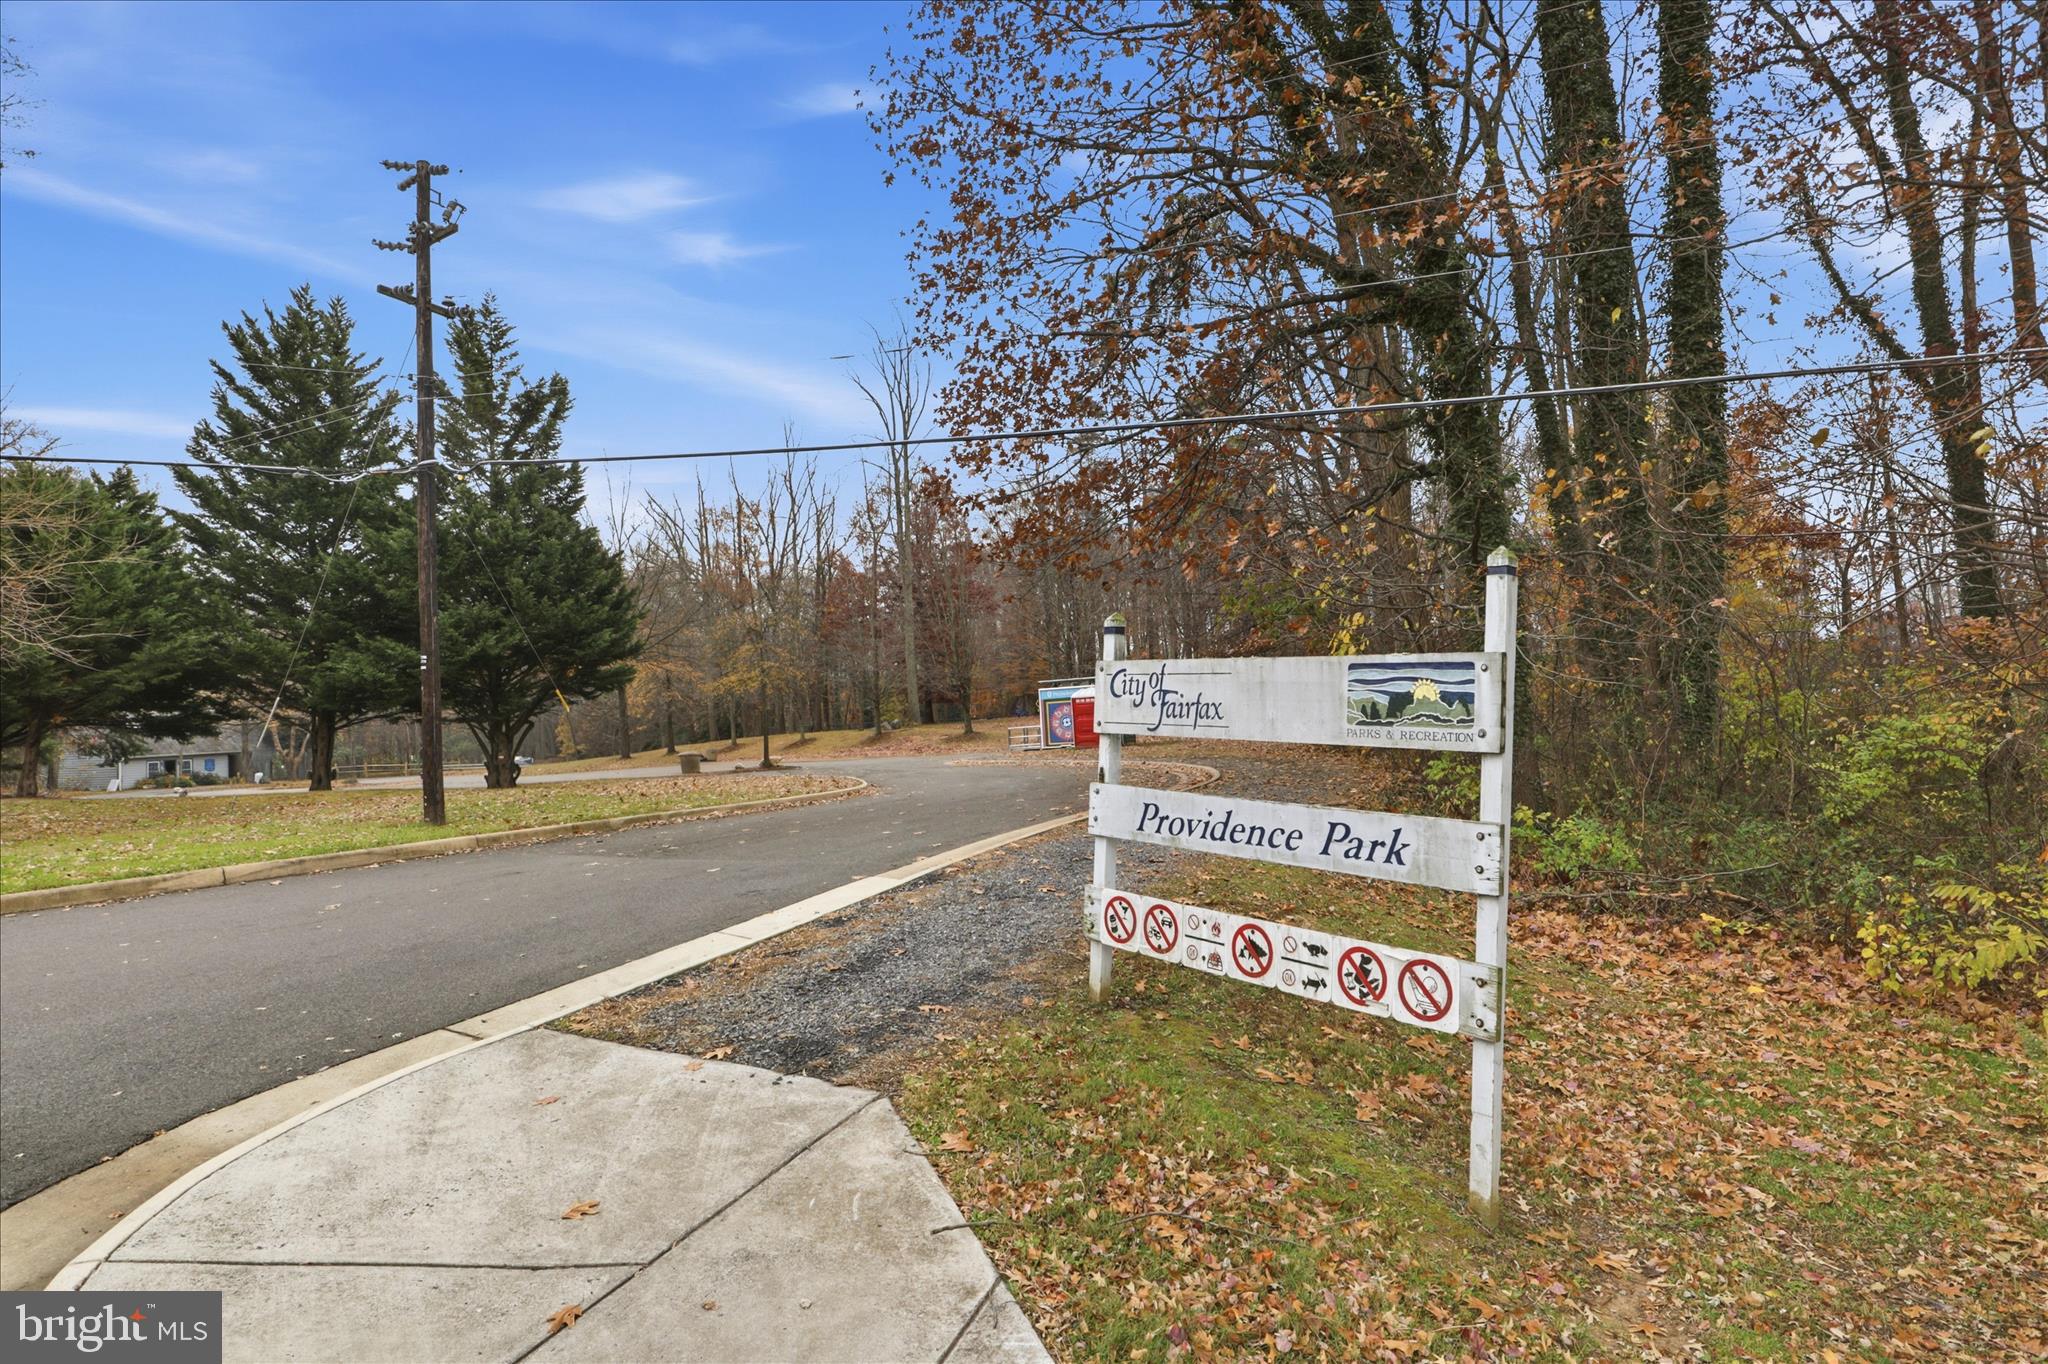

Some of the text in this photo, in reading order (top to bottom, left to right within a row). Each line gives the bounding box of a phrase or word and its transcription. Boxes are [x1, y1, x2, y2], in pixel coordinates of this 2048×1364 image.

[1110, 663, 1166, 708] City of
[1147, 689, 1224, 731] Fairfax
[1346, 728, 1474, 742] PARKS & RECREATION
[1136, 802, 1411, 866] Providence Park
